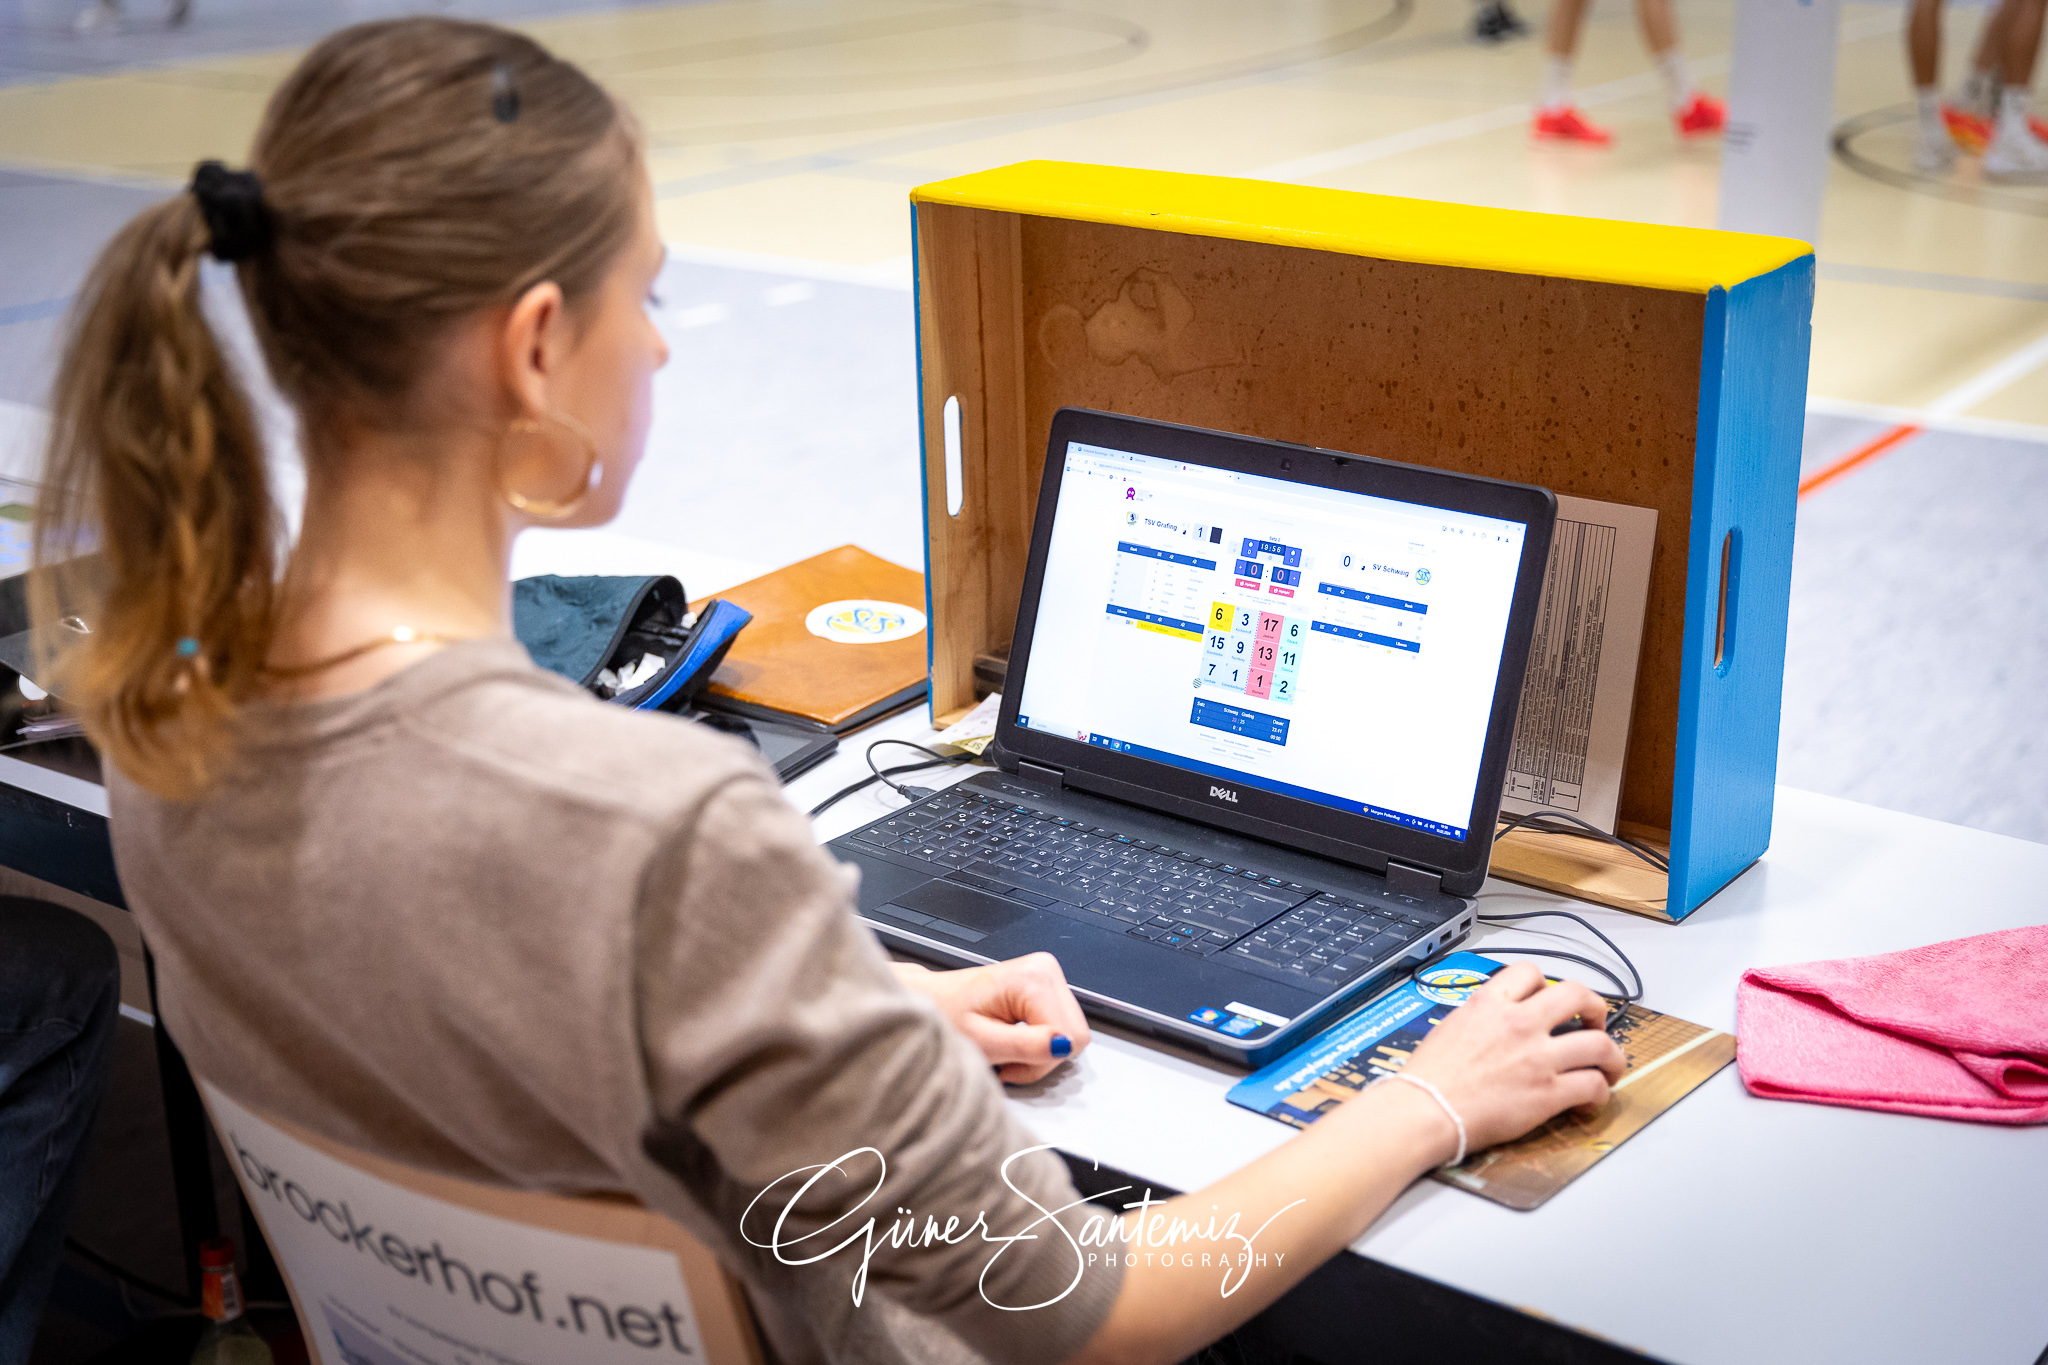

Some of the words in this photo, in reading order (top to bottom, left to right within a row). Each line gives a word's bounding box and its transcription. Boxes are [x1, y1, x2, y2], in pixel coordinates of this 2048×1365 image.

[1144, 518, 1156, 527] TSV
[1156, 520, 1178, 532] Grafing
[1198, 527, 1204, 538] 1
[1260, 543, 1282, 553] 19:56
[1344, 556, 1351, 567] 0
[1251, 564, 1258, 575] 0
[1278, 570, 1284, 580] 0
[1383, 566, 1410, 578] Schwaig
[1216, 608, 1223, 620] 6
[1242, 614, 1249, 626] 3
[1264, 618, 1278, 632] 17
[1291, 624, 1298, 636] 6
[1210, 636, 1225, 649] 15
[1236, 642, 1244, 653] 9
[1259, 647, 1273, 660] 13
[1283, 652, 1296, 665] 11
[1209, 663, 1216, 675] 7
[1232, 670, 1238, 682] 1
[1257, 675, 1263, 687] 1
[1280, 680, 1288, 693] 2
[1210, 786, 1238, 803] DELL
[229, 1127, 694, 1356] brockerhof.net
